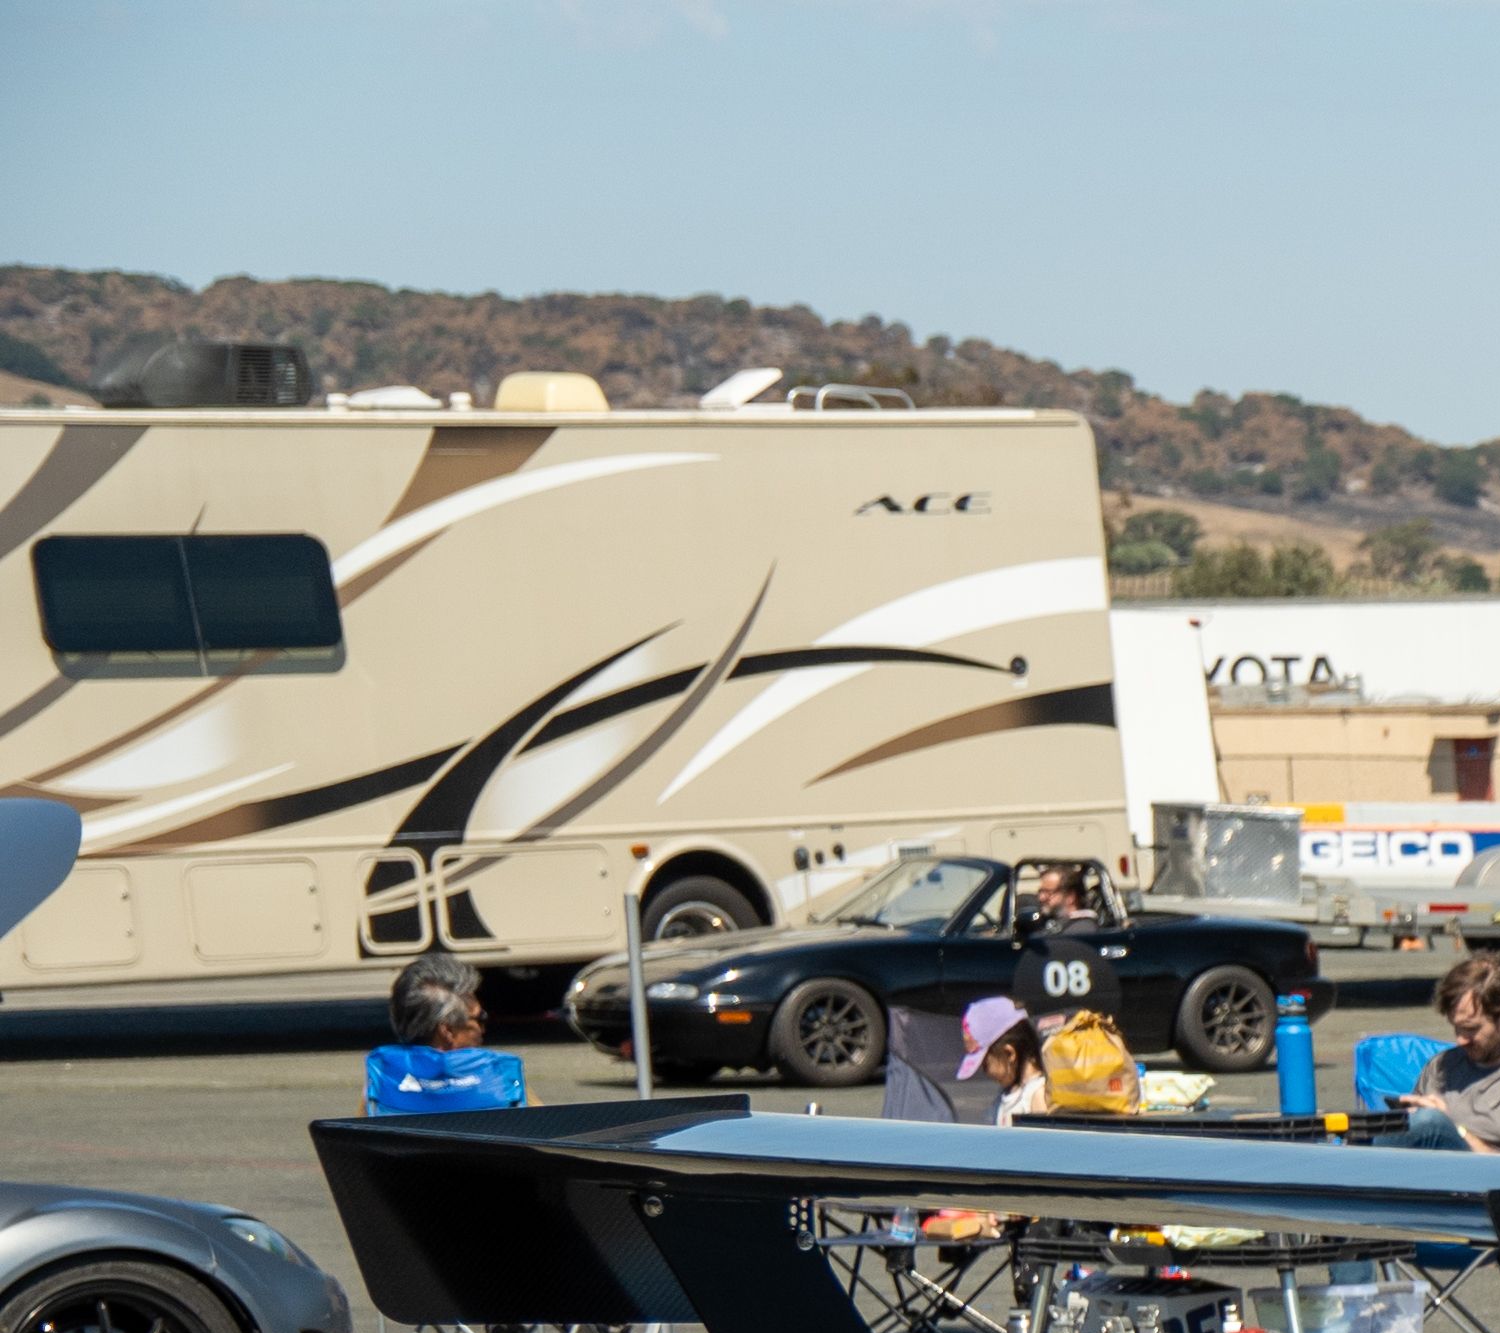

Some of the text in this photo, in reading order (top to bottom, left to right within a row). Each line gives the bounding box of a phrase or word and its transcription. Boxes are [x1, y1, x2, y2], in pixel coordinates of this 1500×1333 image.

[854, 491, 992, 516] ACE
[1302, 830, 1474, 869] GEICO
[1043, 961, 1091, 997] 08
